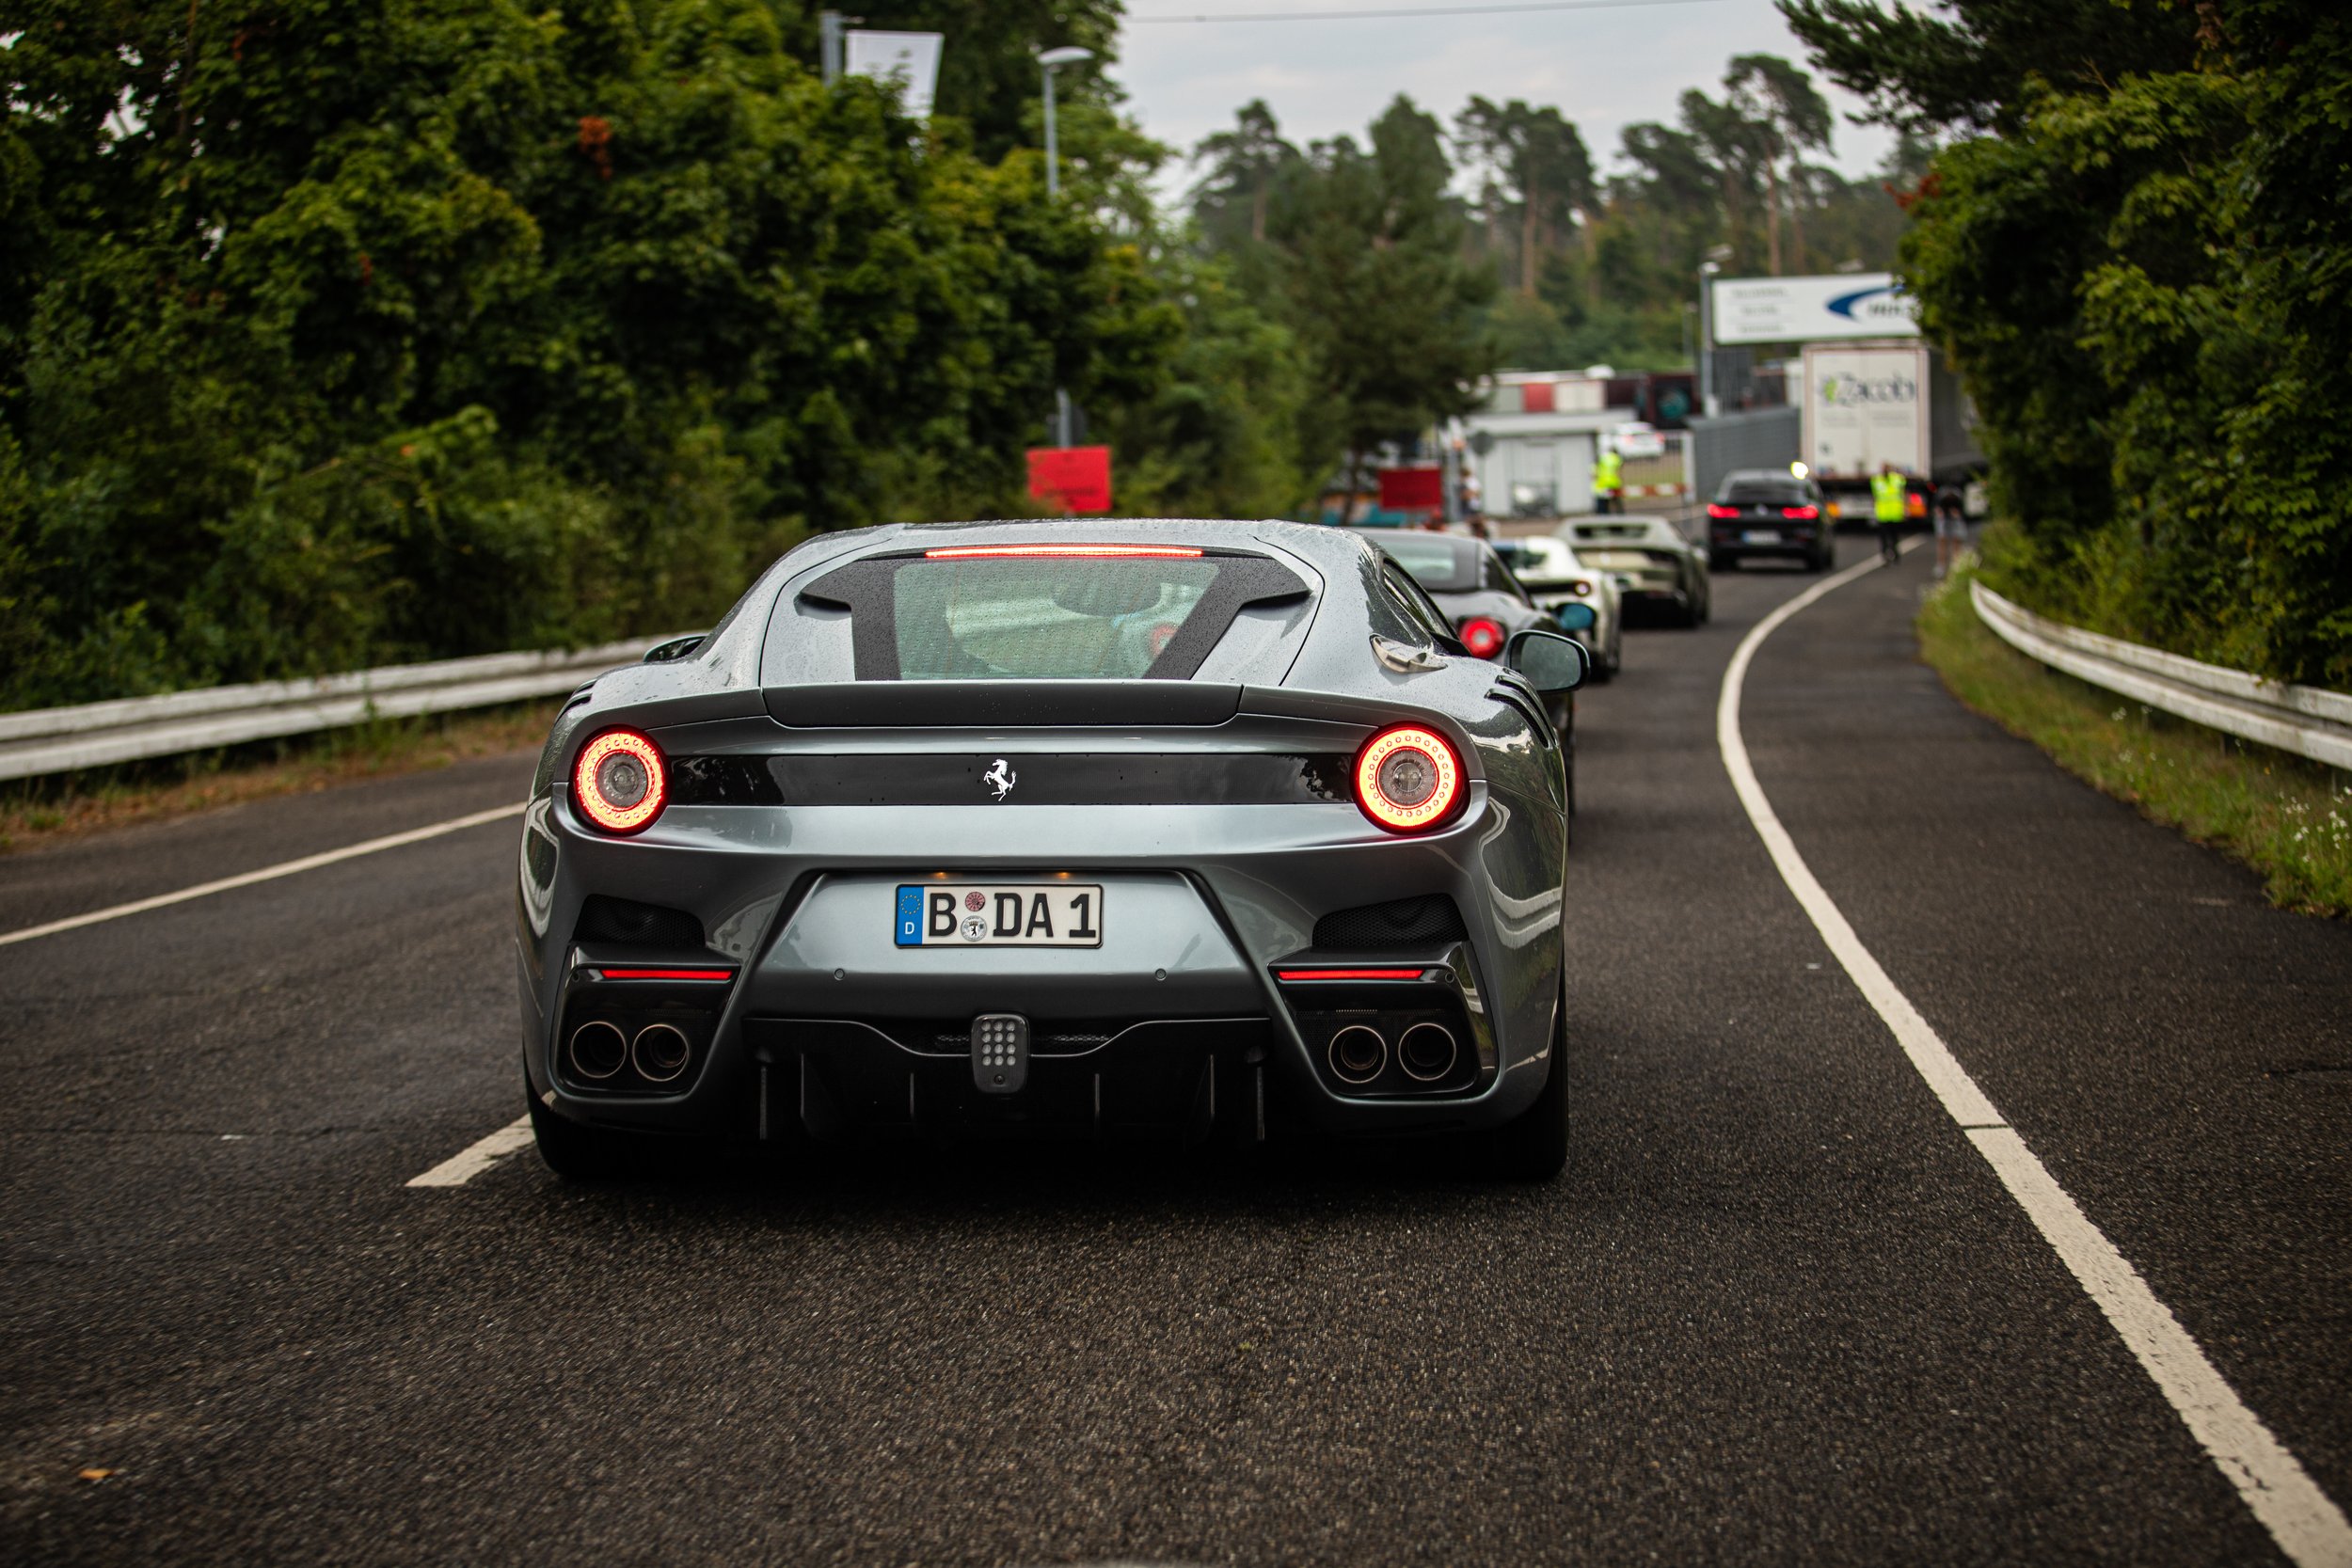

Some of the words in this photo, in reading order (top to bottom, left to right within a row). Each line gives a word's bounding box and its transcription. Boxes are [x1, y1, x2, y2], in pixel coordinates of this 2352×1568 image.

[904, 922, 915, 935] D
[929, 893, 958, 937] B
[993, 893, 1054, 938] DA
[1069, 894, 1096, 938] 1
